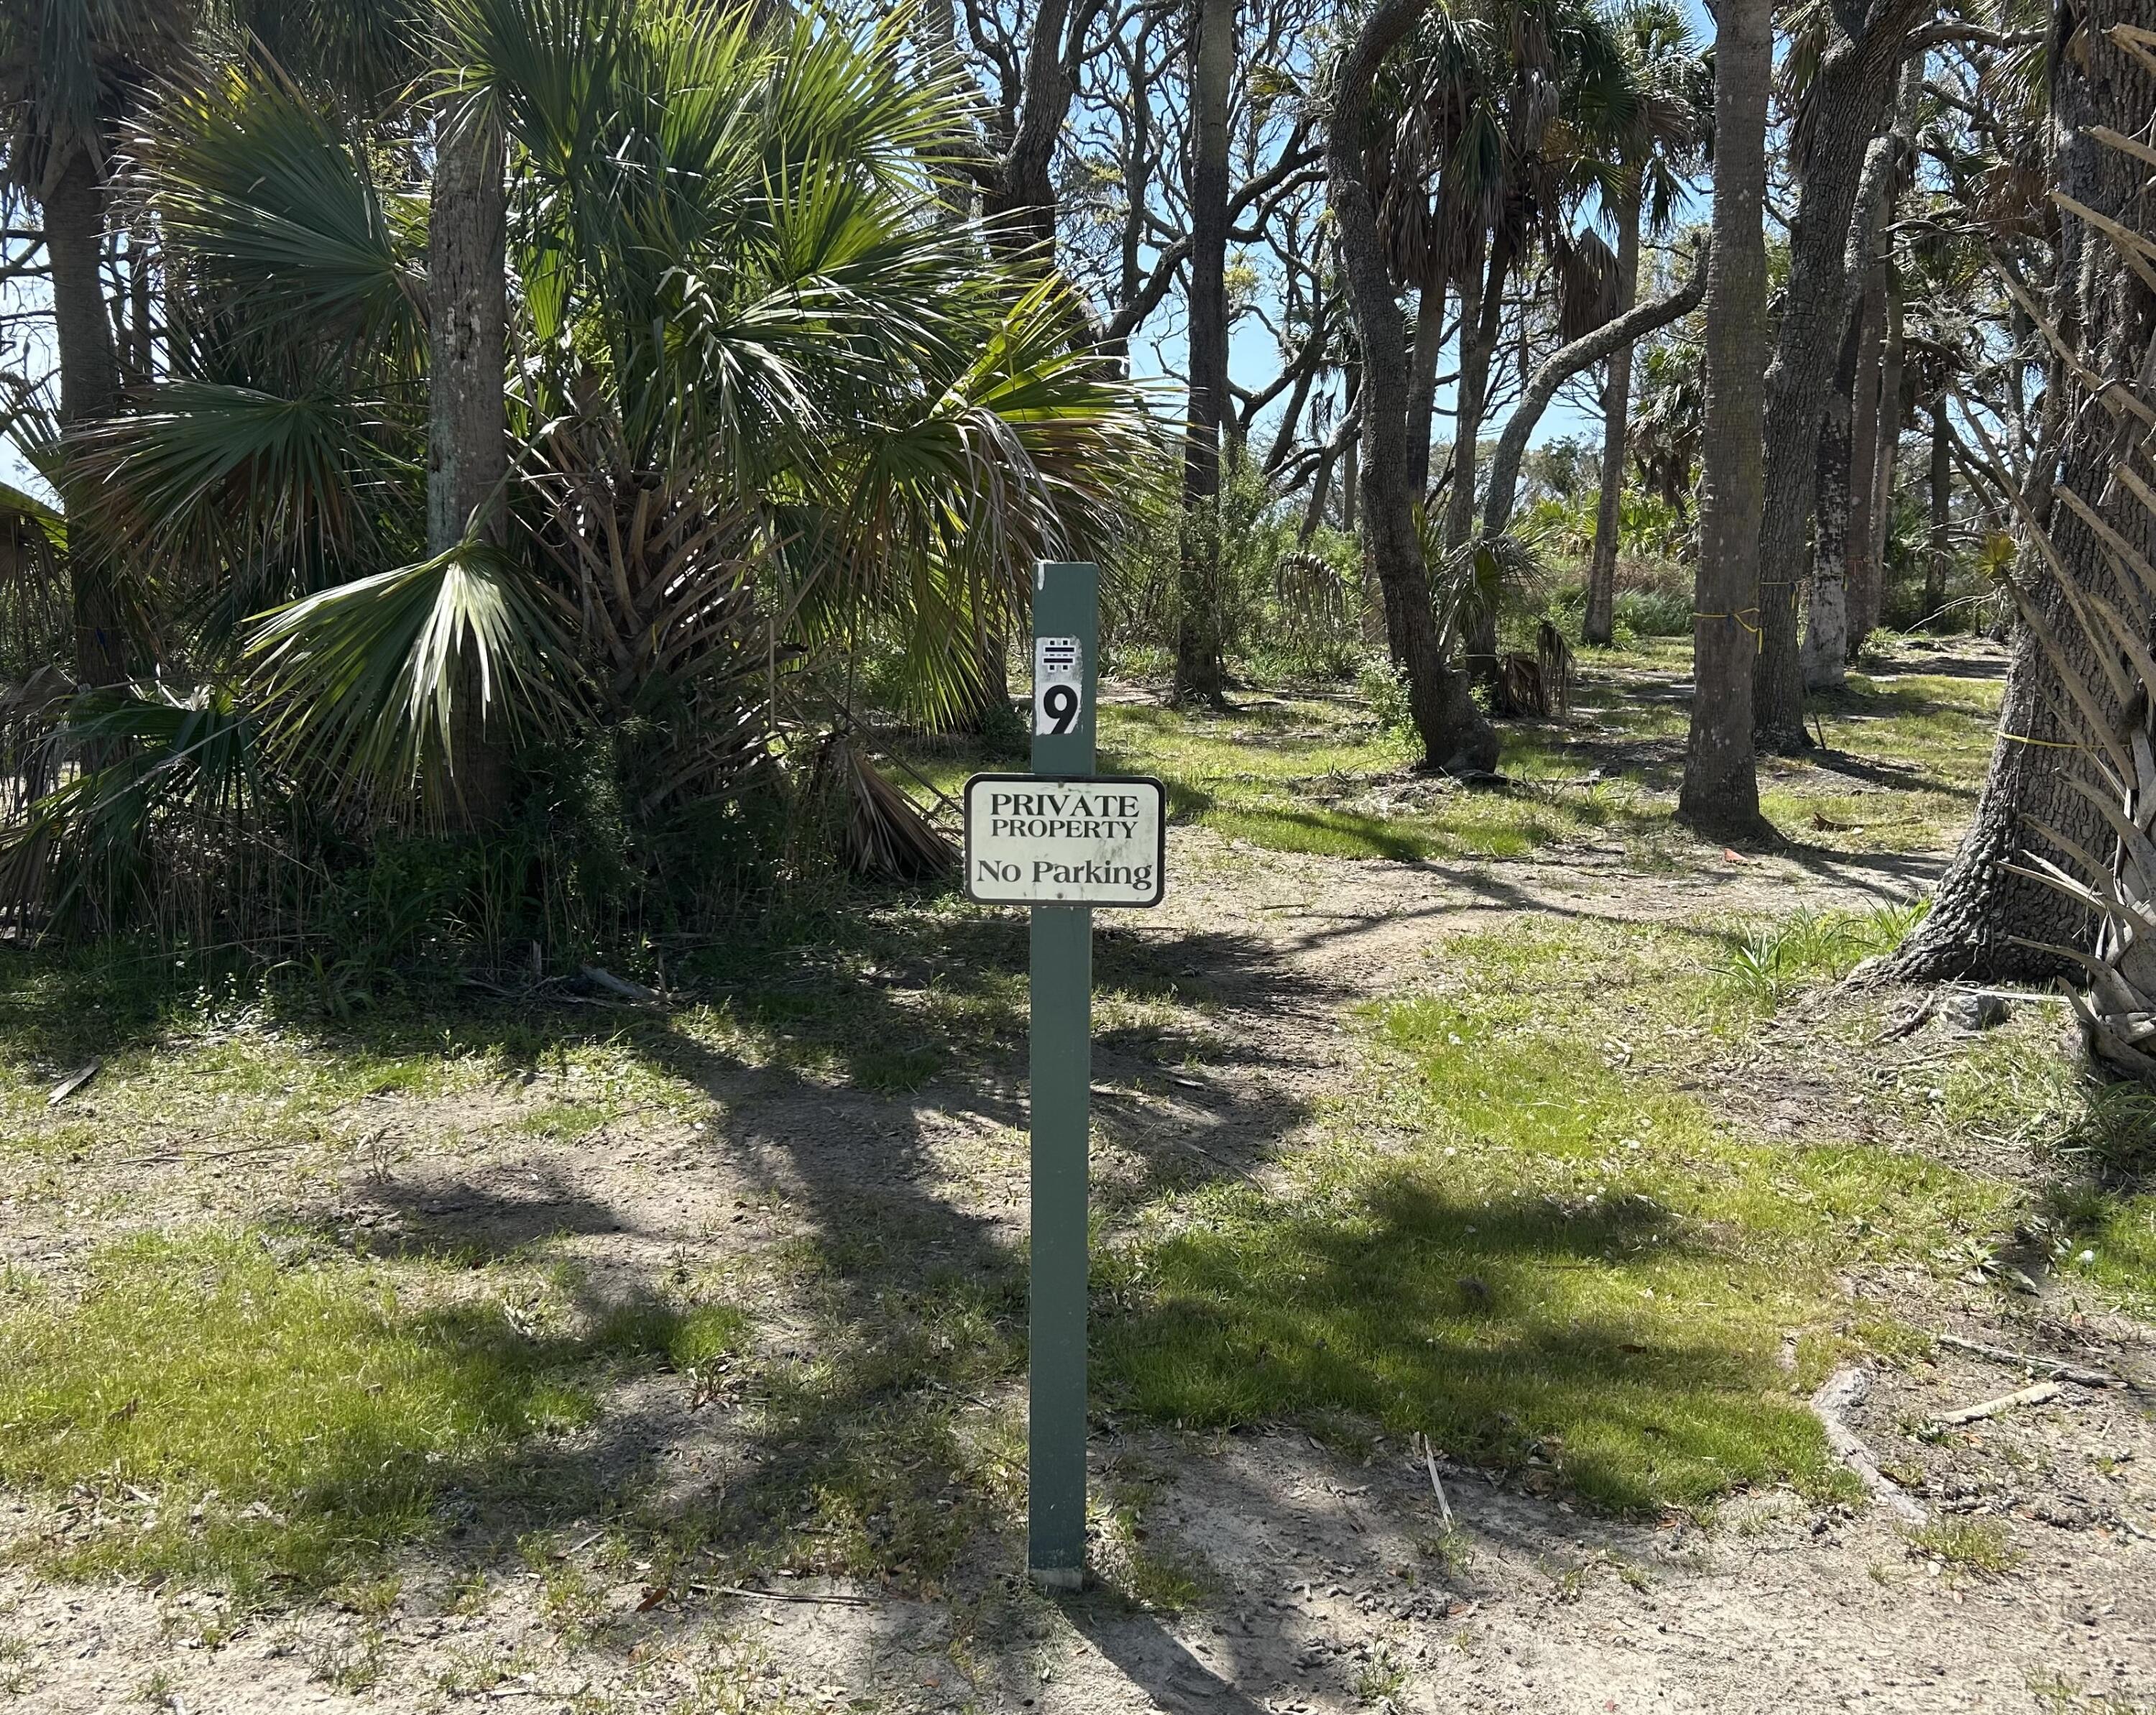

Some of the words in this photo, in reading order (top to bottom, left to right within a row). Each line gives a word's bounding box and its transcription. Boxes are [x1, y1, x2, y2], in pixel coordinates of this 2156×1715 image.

[1043, 684, 1078, 735] 9
[990, 794, 1140, 818] PRIVATE
[991, 819, 1138, 839] PROPERTY
[977, 860, 1022, 883] No
[1032, 860, 1153, 891] Parking
